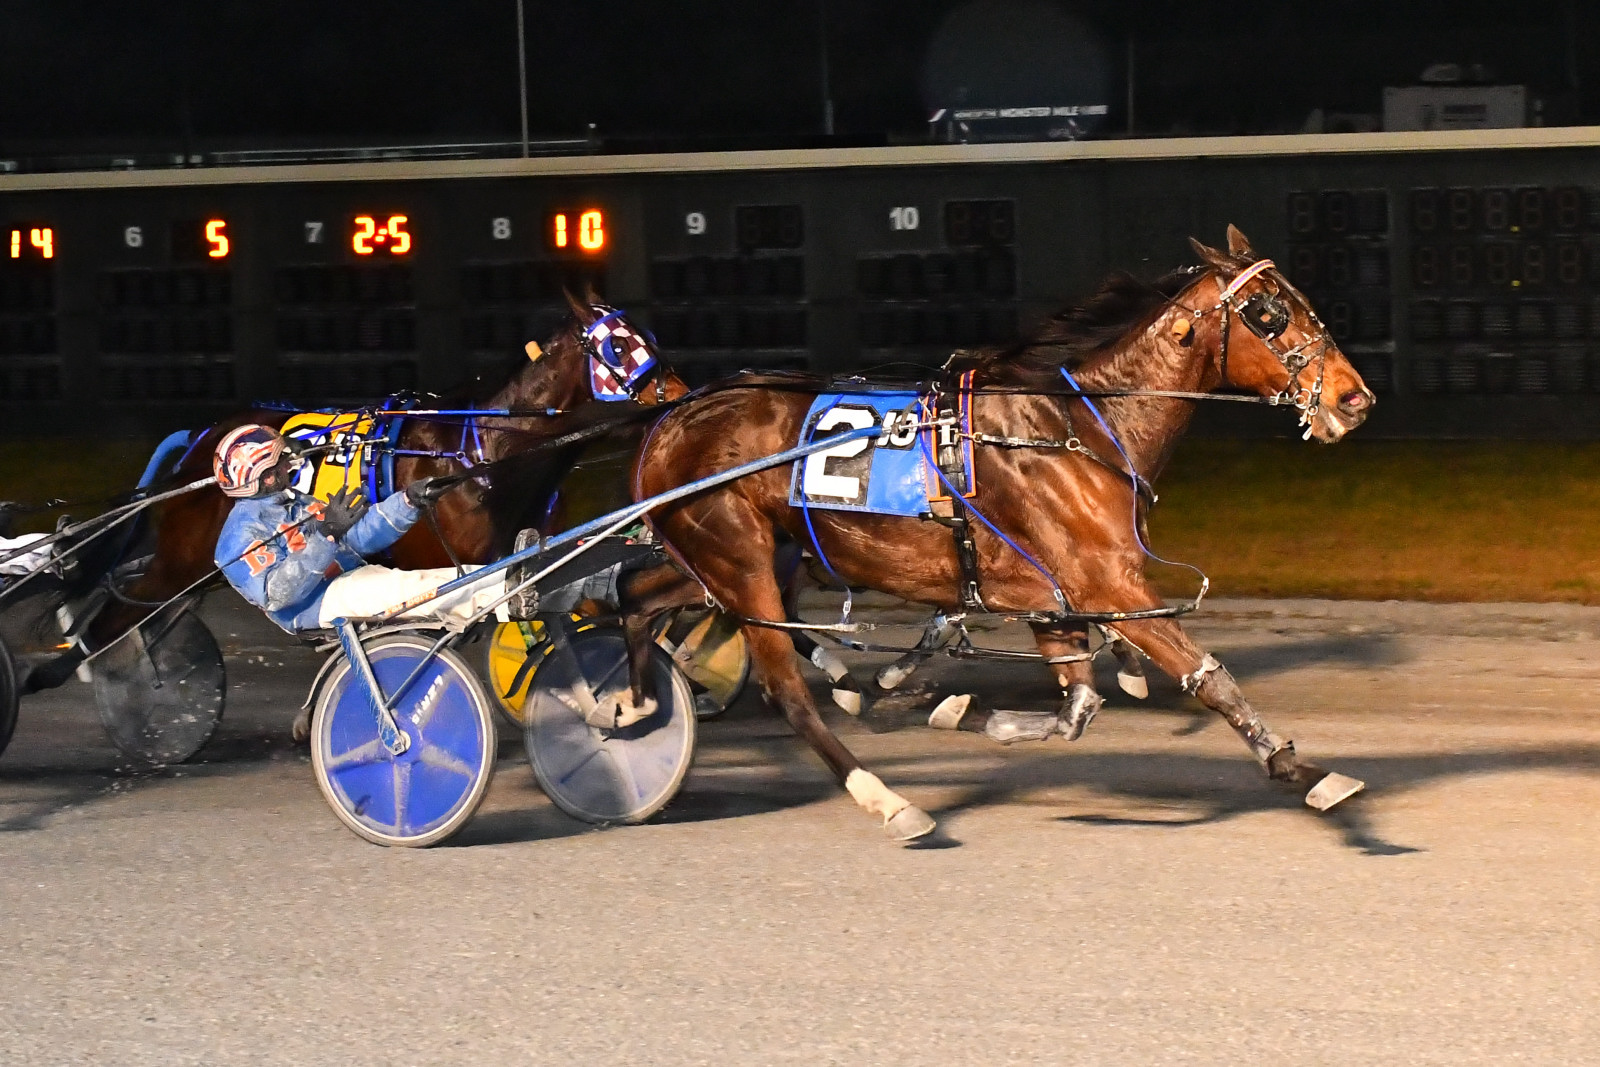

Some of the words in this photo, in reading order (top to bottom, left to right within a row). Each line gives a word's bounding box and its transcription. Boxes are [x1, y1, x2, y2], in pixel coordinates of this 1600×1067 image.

[493, 217, 511, 240] 8
[686, 212, 706, 235] 9
[889, 206, 919, 230] 10
[125, 226, 142, 248] 6
[205, 219, 230, 259] 5
[306, 222, 322, 244] 7
[555, 210, 605, 252] 10
[803, 407, 875, 499] 2
